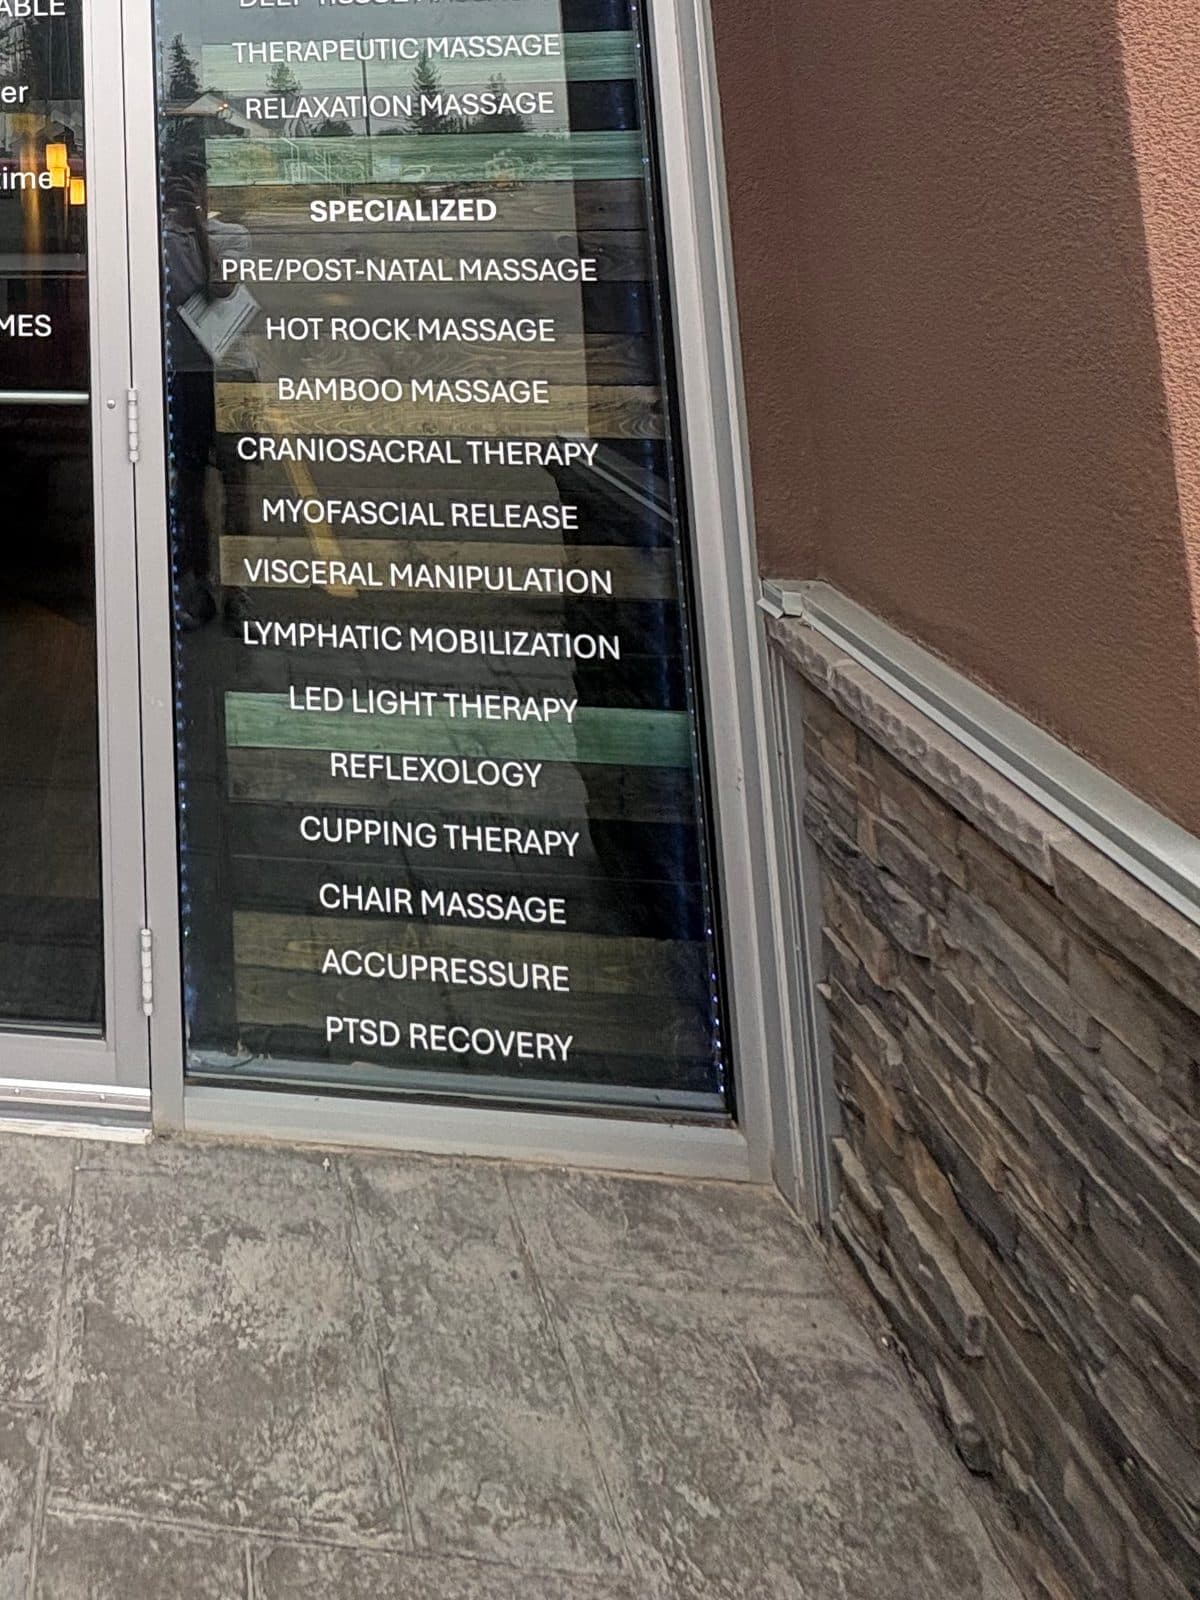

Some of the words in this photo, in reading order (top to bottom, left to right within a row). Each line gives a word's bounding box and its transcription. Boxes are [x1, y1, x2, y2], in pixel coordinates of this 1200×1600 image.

[232, 38, 419, 63] THERAPEUTIC
[427, 34, 561, 58] MASSAGE
[245, 96, 412, 119] RELAXATION
[420, 92, 554, 116] MASSAGE
[310, 200, 496, 223] SPECIALIZED
[222, 259, 452, 282] PRE/POST-NATAL
[459, 258, 597, 282] MASSAGE
[266, 317, 324, 340] HOT
[330, 318, 411, 341] ROCK
[418, 319, 555, 342] MASSAGE
[278, 378, 403, 401] BAMBOO
[411, 379, 549, 404] MASSAGE
[237, 438, 460, 465] CRANIOSACRAL
[466, 442, 599, 467] THERAPY
[262, 499, 444, 526] MYOFASCIAL
[451, 504, 578, 529] RELEASE
[244, 559, 382, 586] VISCERAL
[390, 564, 612, 594] MANIPULATION
[243, 621, 402, 650] LYMPHATIC
[410, 628, 620, 660] MOBILIZATION
[289, 687, 343, 712] LED
[352, 690, 435, 716] LIGHT
[443, 694, 578, 724] THERAPY
[331, 753, 541, 788] REFLEXOLOGY
[300, 817, 437, 848] CUPPING
[443, 825, 579, 857] THERAPY
[319, 884, 413, 915] CHAIR
[422, 890, 566, 924] MASSAGE
[321, 950, 569, 992] ACCUPRESSURE
[326, 1018, 400, 1046] PTSD
[409, 1025, 573, 1061] RECOVERY
